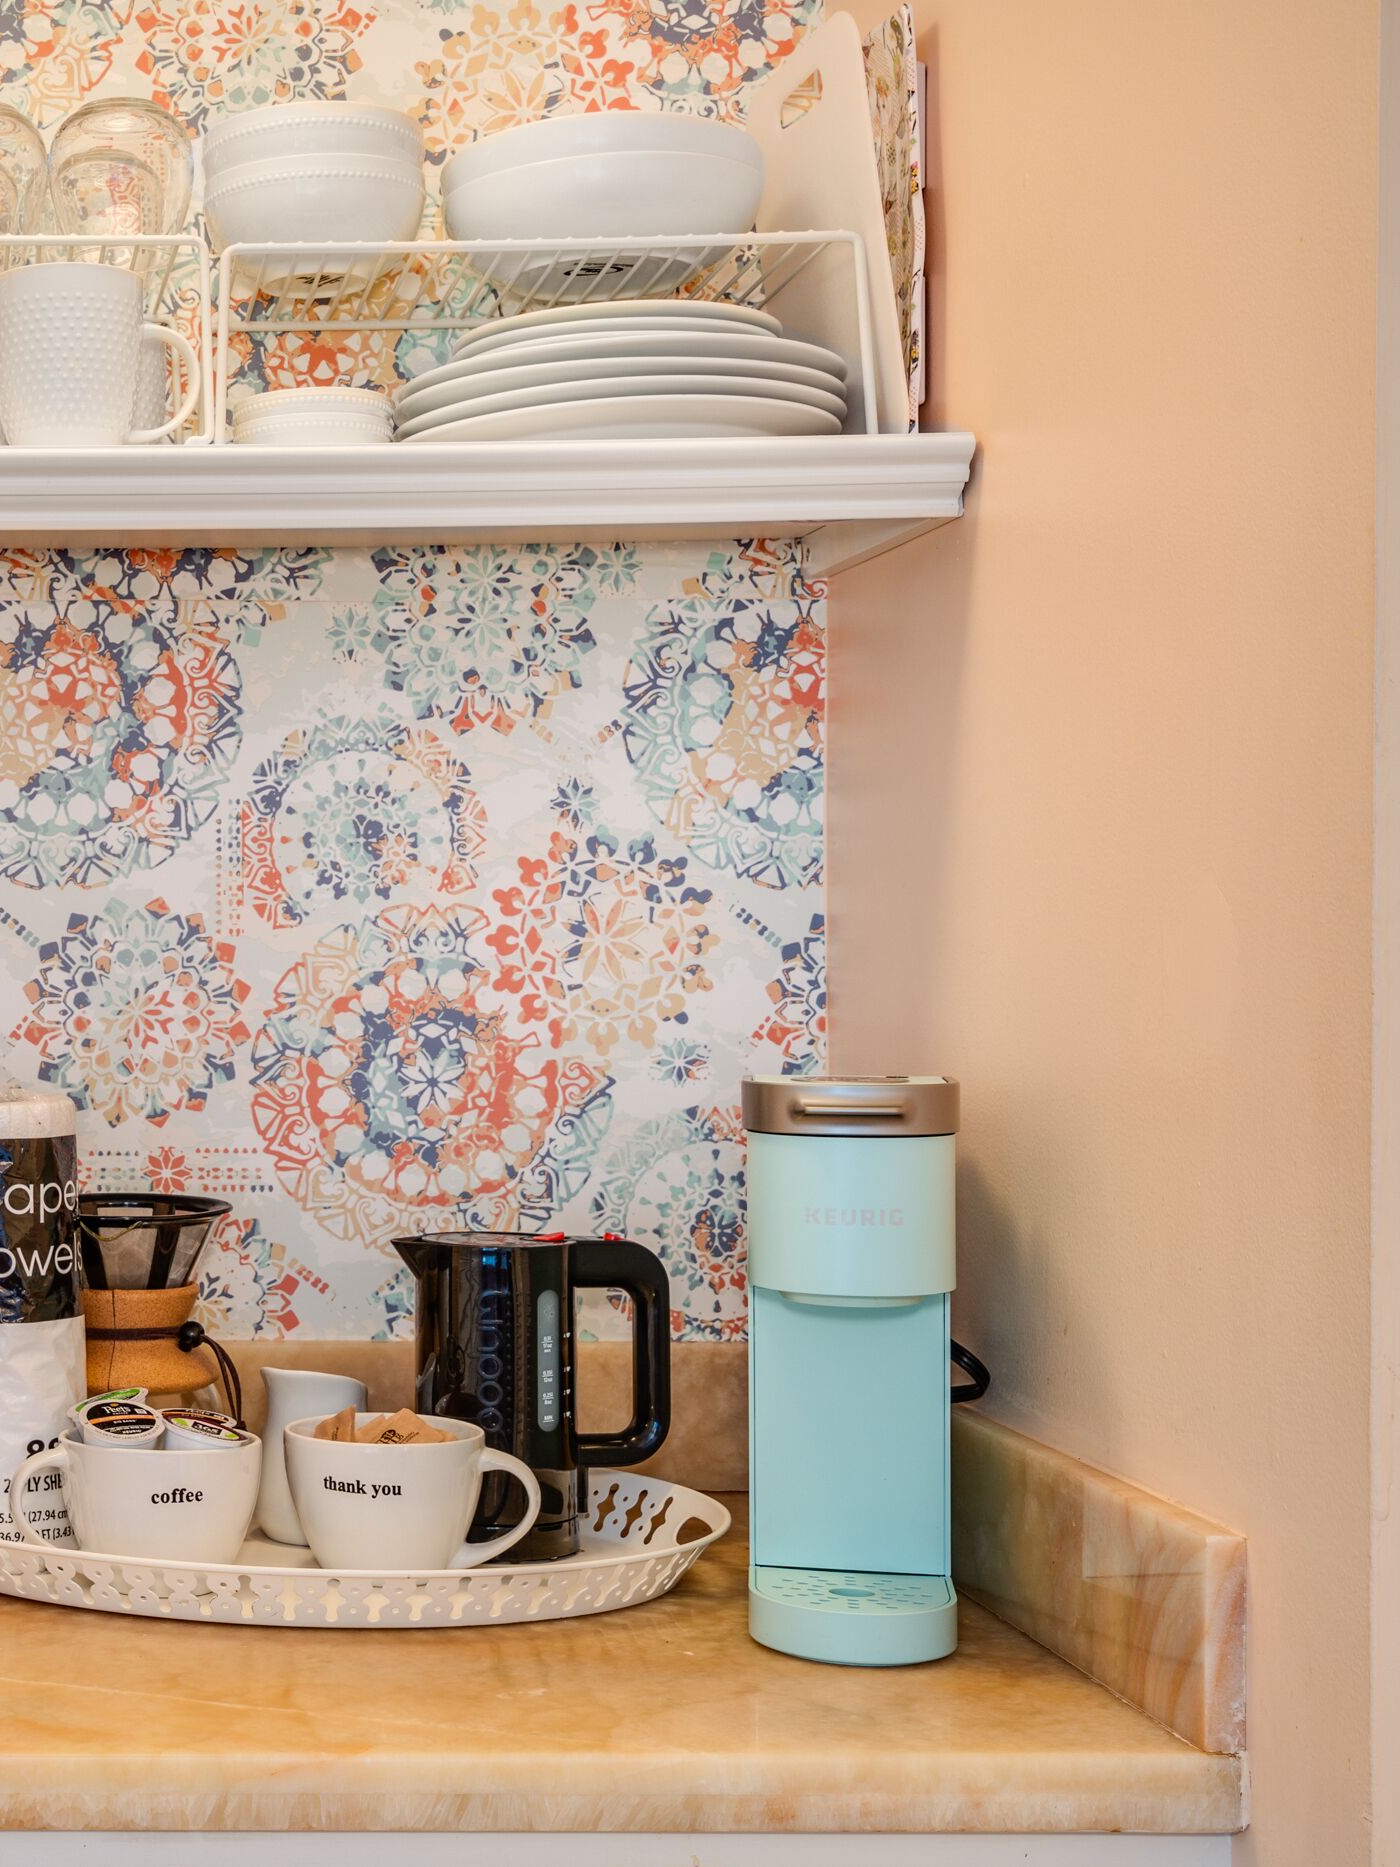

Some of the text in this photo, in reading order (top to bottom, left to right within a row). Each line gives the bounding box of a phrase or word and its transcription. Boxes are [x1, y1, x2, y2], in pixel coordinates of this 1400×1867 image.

[804, 1206, 905, 1227] KEURIG
[151, 1488, 204, 1504] coffee
[323, 1475, 402, 1499] thank you
[41, 1528, 51, 1540] FT
